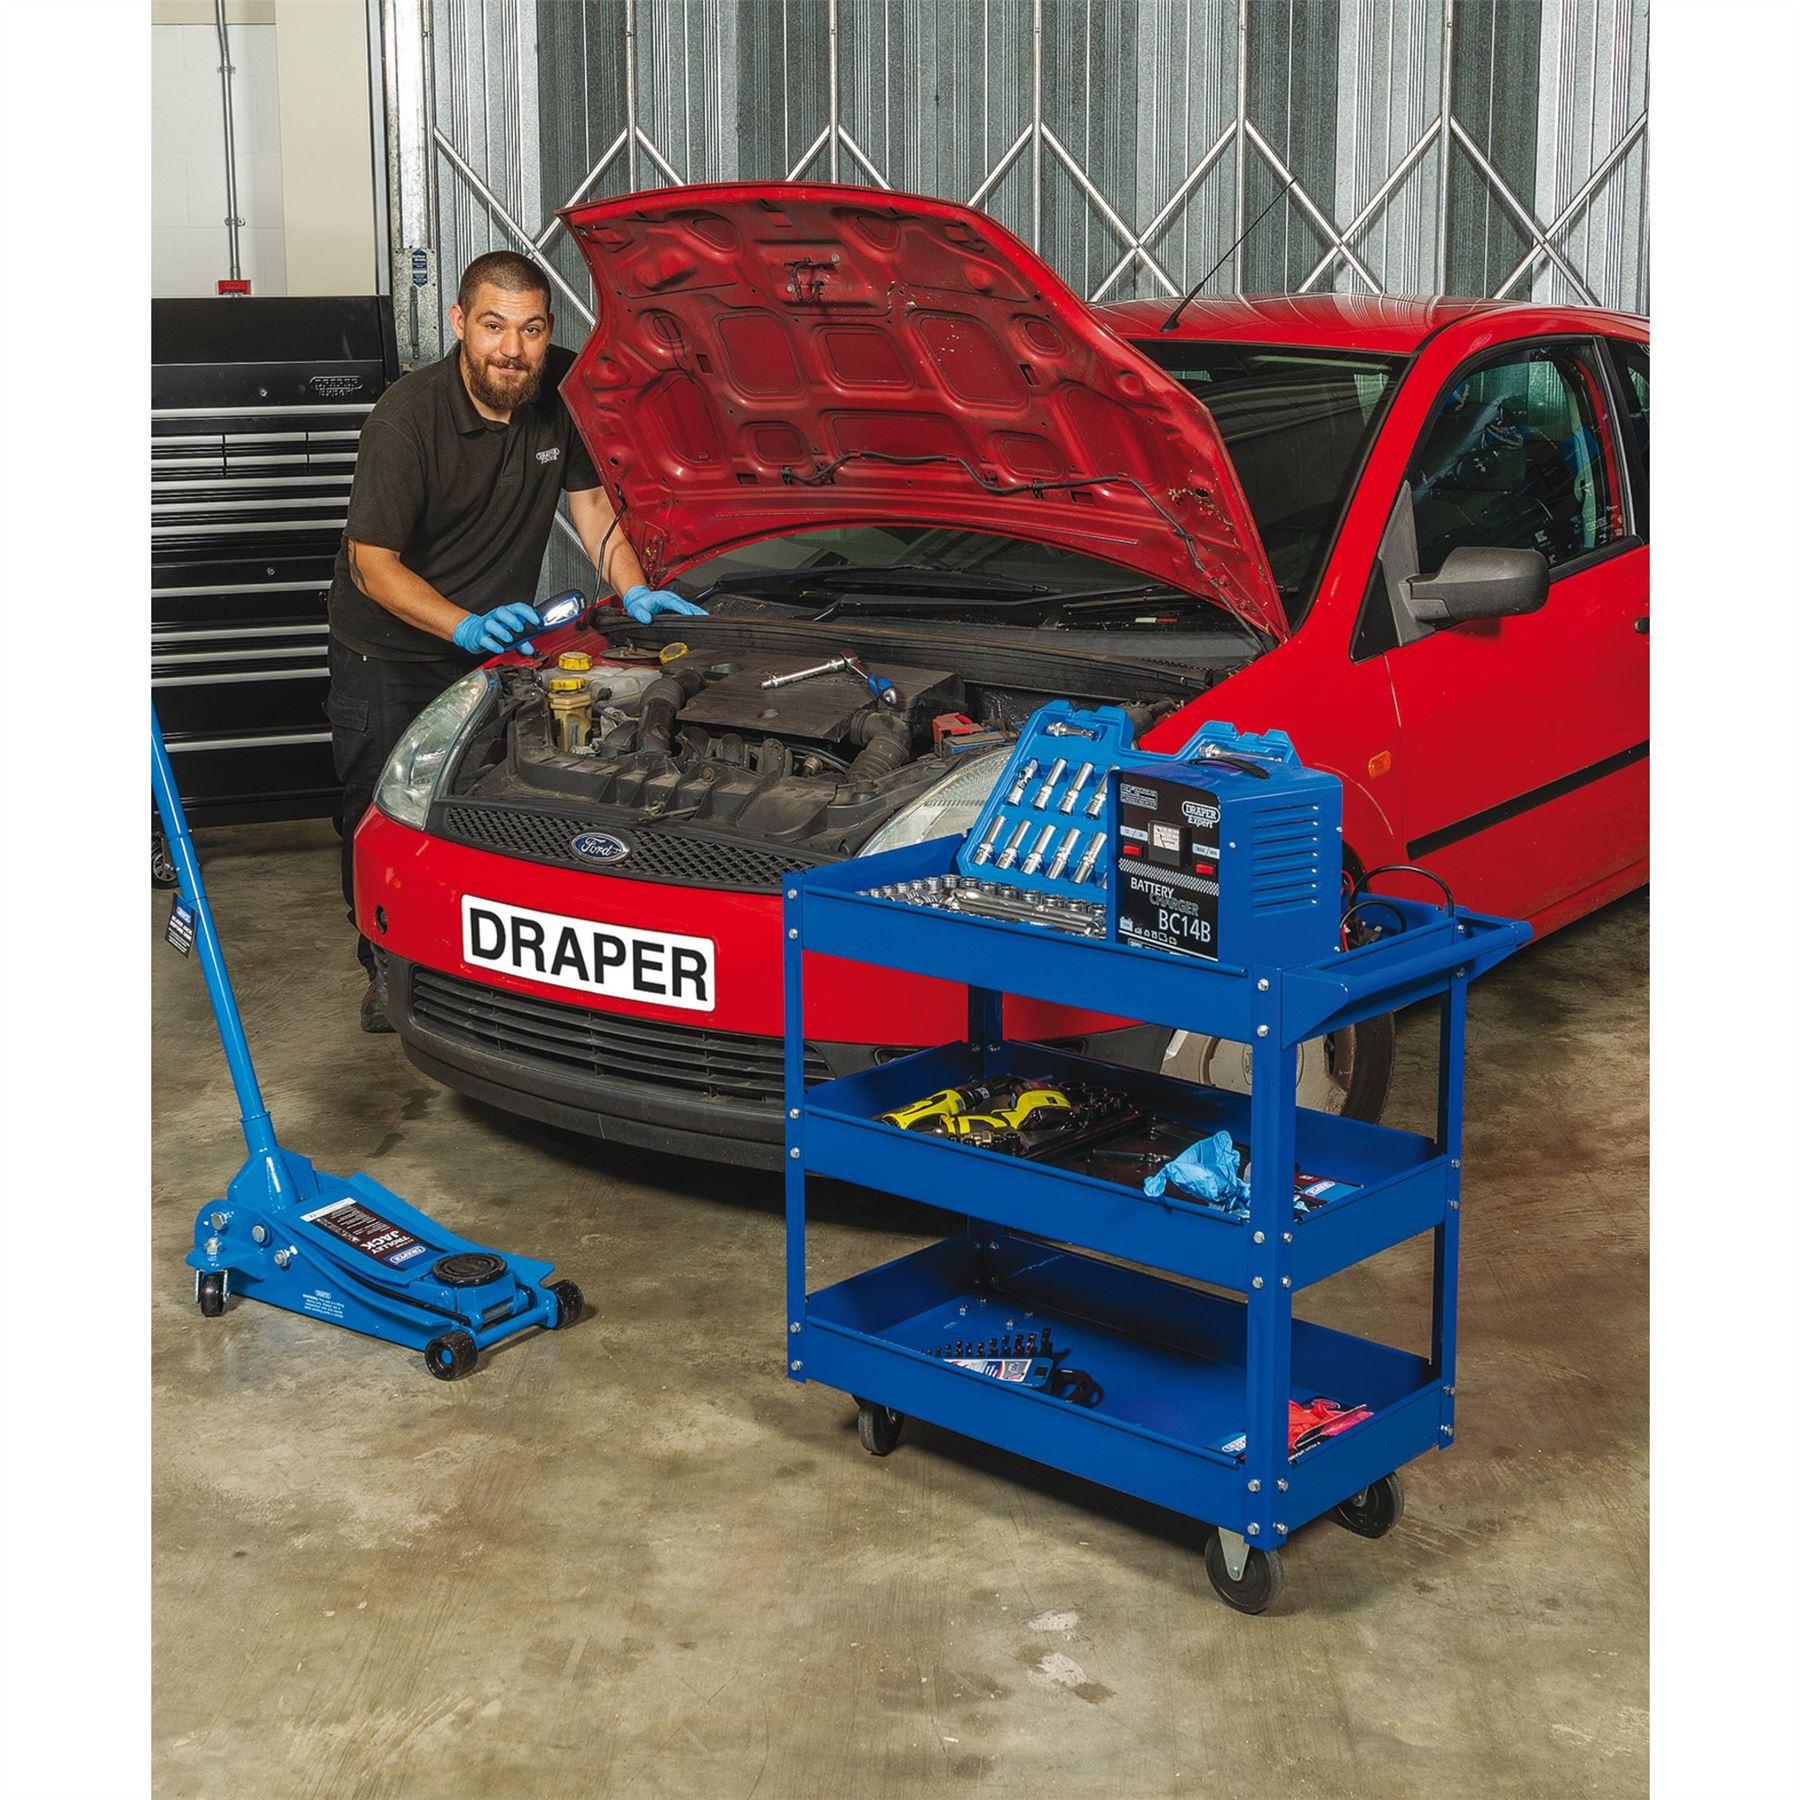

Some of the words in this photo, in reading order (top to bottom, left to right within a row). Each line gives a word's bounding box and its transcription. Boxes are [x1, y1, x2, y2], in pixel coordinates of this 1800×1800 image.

[1184, 804, 1217, 820] DRAPER
[1187, 816, 1213, 829] Expert
[580, 838, 617, 856] Ford
[1130, 877, 1174, 898] BATTERY
[1149, 893, 1199, 917] CHARGER
[1159, 908, 1211, 943] BC14B
[469, 907, 708, 1002] DRAPER
[360, 1230, 400, 1250] JACK
[372, 1235, 410, 1254] TROLLEY
